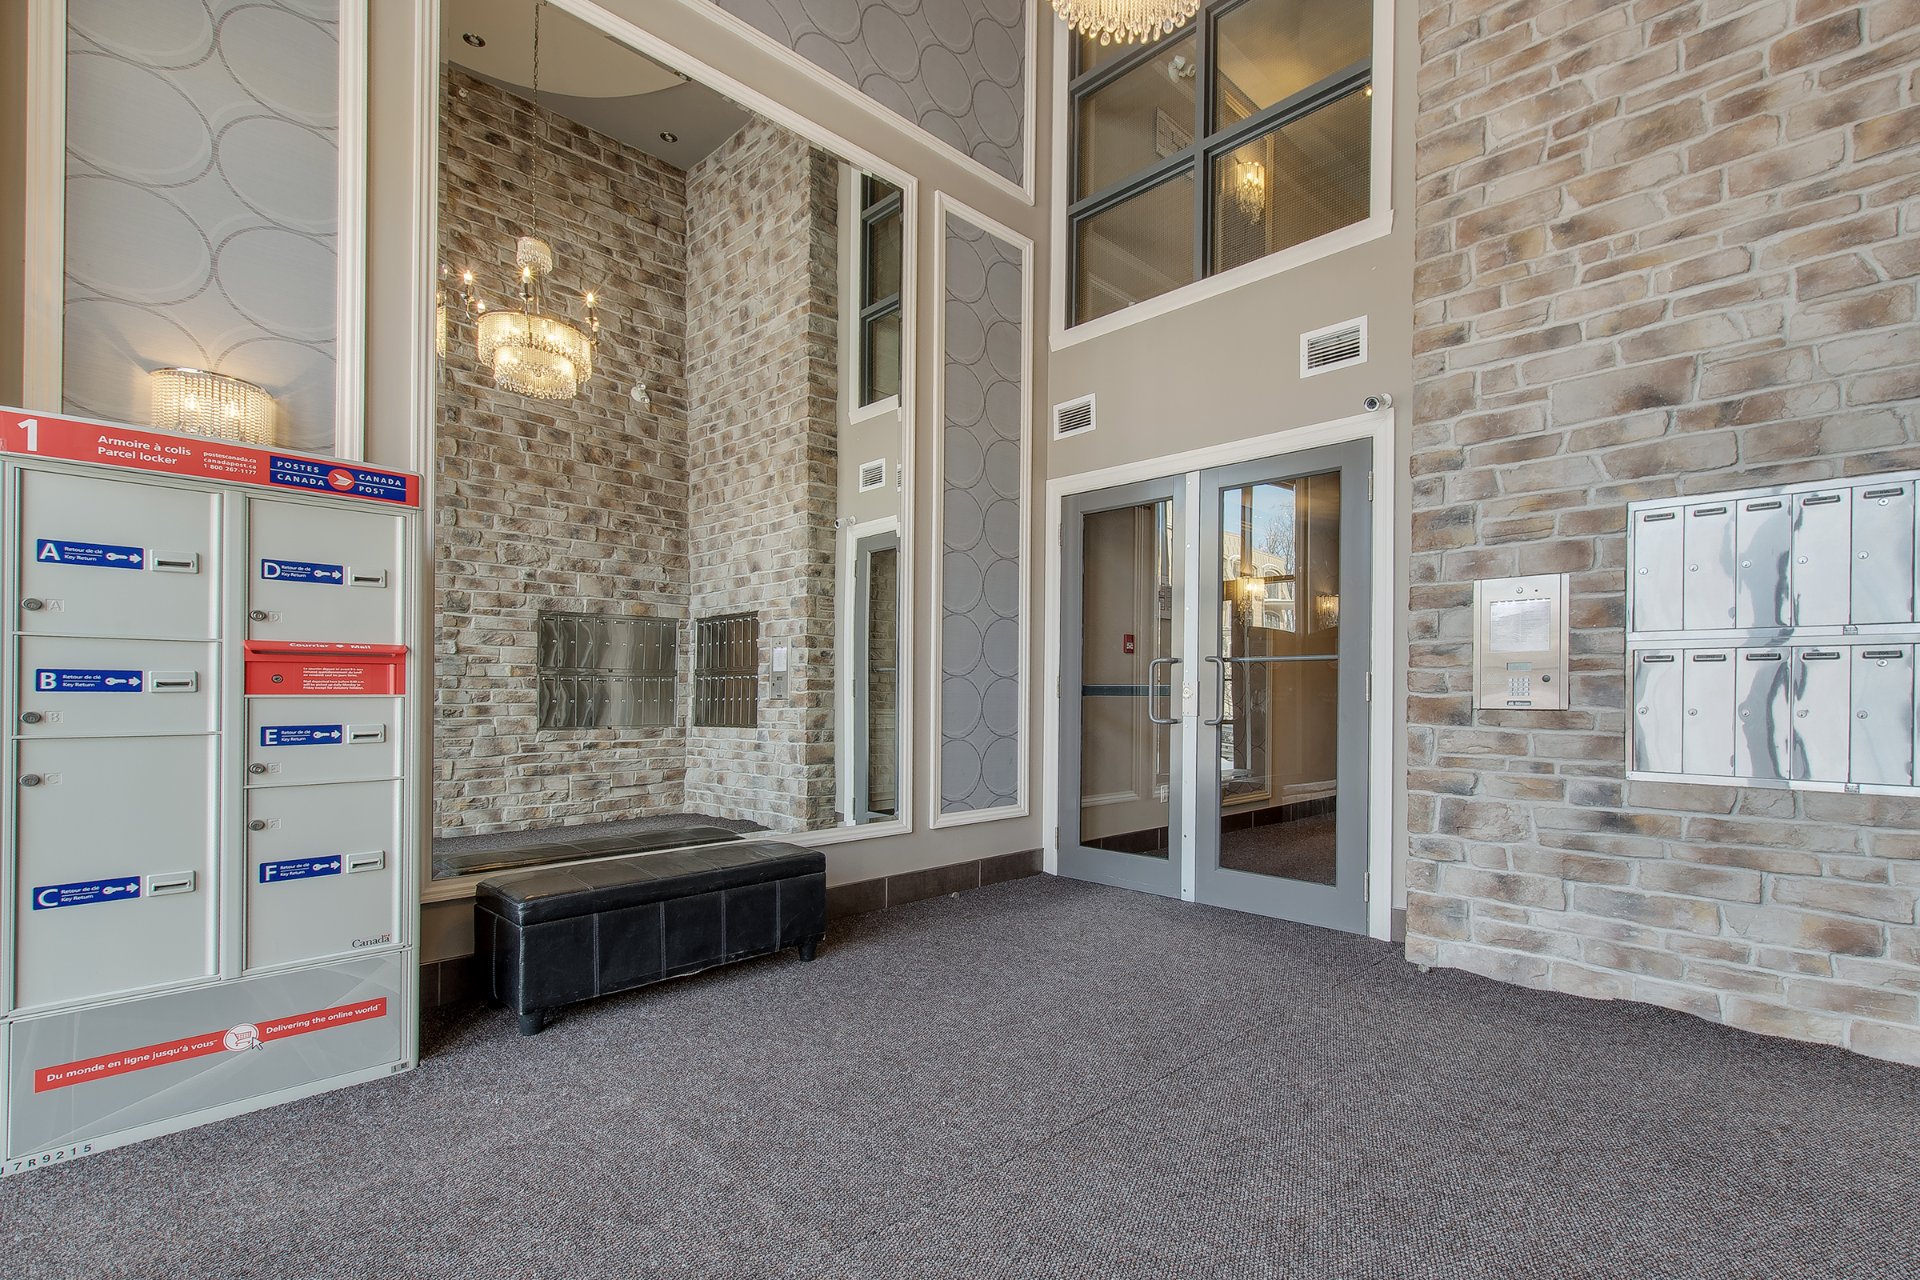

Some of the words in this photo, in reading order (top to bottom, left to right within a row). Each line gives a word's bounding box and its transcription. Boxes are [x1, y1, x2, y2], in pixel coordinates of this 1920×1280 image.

[17, 419, 38, 452] 1
[98, 435, 151, 450] Armoire
[154, 442, 161, 451] à
[164, 445, 192, 456] colis
[98, 446, 136, 459] Parcel
[140, 451, 178, 465] locker
[203, 451, 257, 464] postescanada.ca
[203, 458, 257, 470] canadapost.ca
[277, 461, 320, 474] POSTES
[277, 474, 325, 487] CANADA
[359, 474, 402, 486] CANADA
[359, 485, 385, 495] POST
[40, 543, 61, 561] A
[264, 562, 281, 578] D
[40, 672, 57, 689] B
[265, 729, 278, 744] E
[265, 864, 278, 881] F
[38, 888, 58, 907] C
[352, 934, 391, 948] Canada
[266, 1019, 310, 1034] Delivering
[312, 1015, 326, 1024] the
[328, 1010, 354, 1021] online
[46, 1073, 63, 1082] Du
[66, 1063, 105, 1078] monde
[107, 1060, 121, 1069] en
[124, 1054, 150, 1066] ligne
